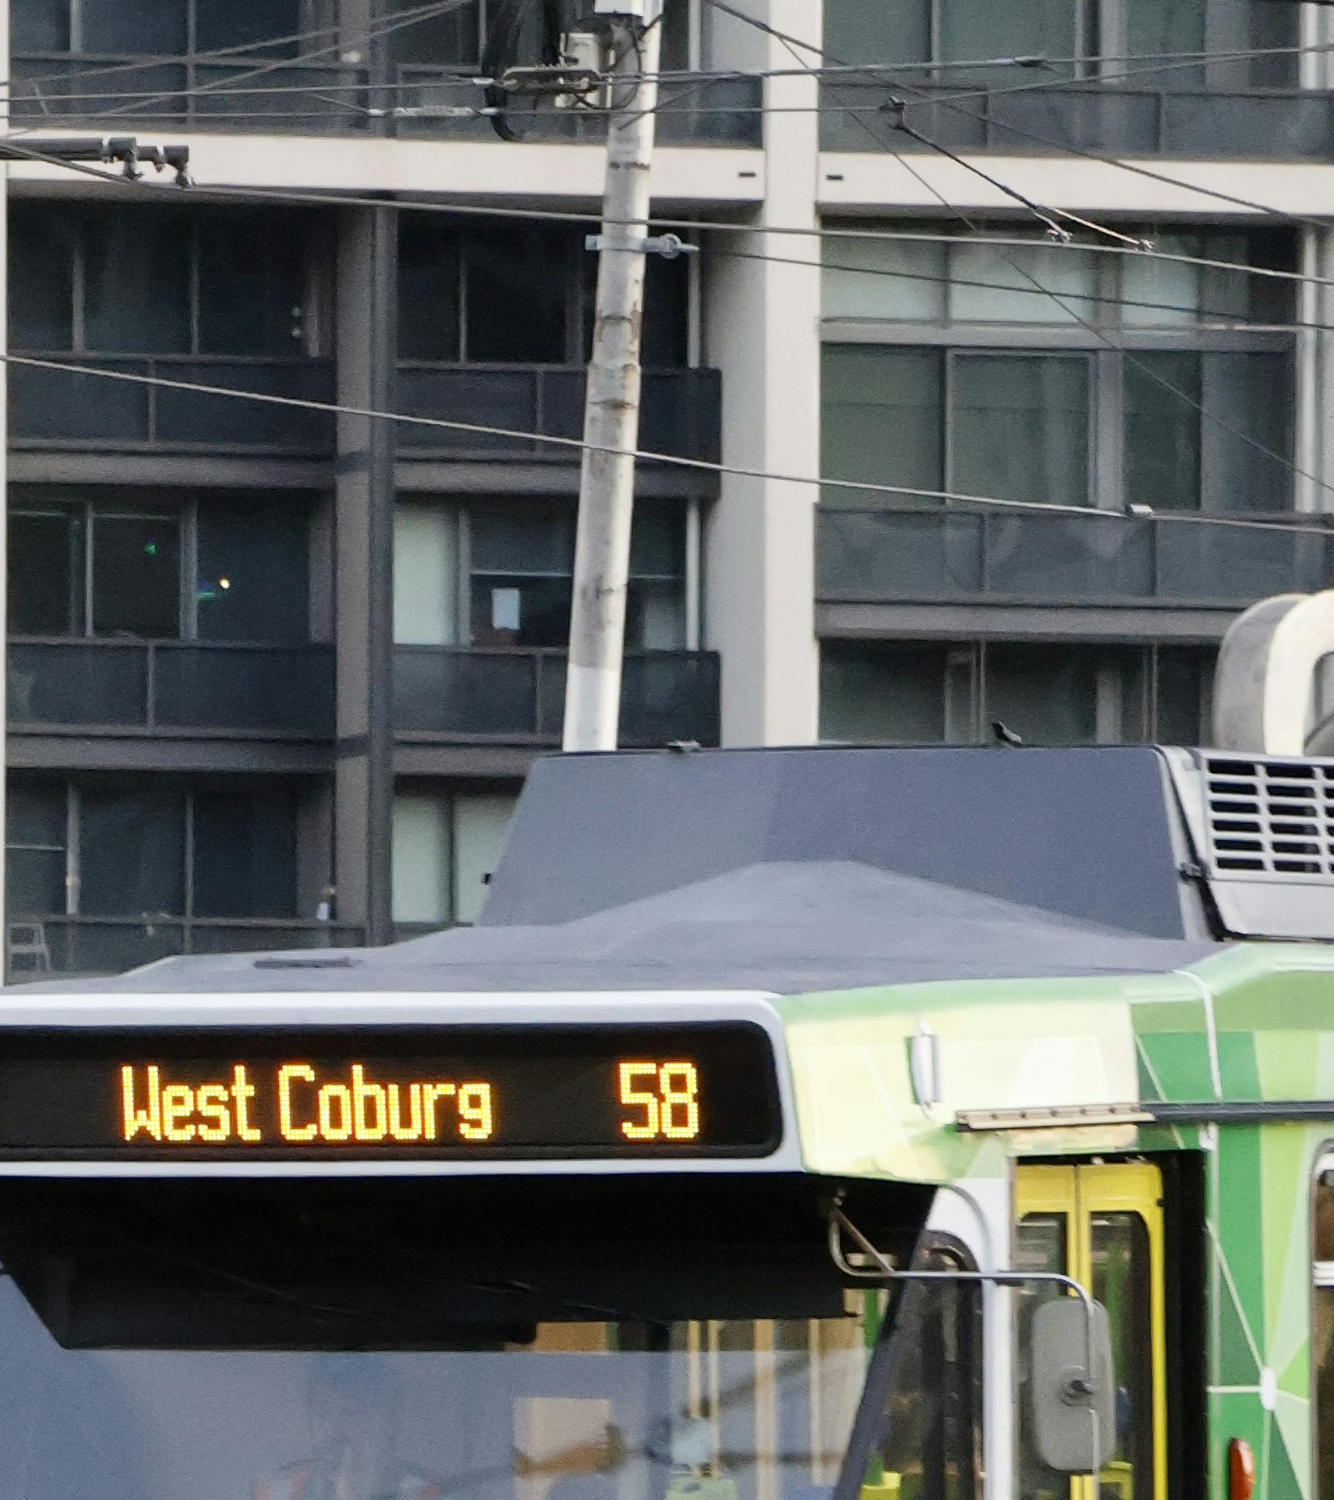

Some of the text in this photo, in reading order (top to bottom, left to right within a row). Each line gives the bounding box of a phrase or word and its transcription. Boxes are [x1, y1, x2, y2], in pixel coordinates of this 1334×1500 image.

[121, 1062, 699, 1141] West Coburg 58
